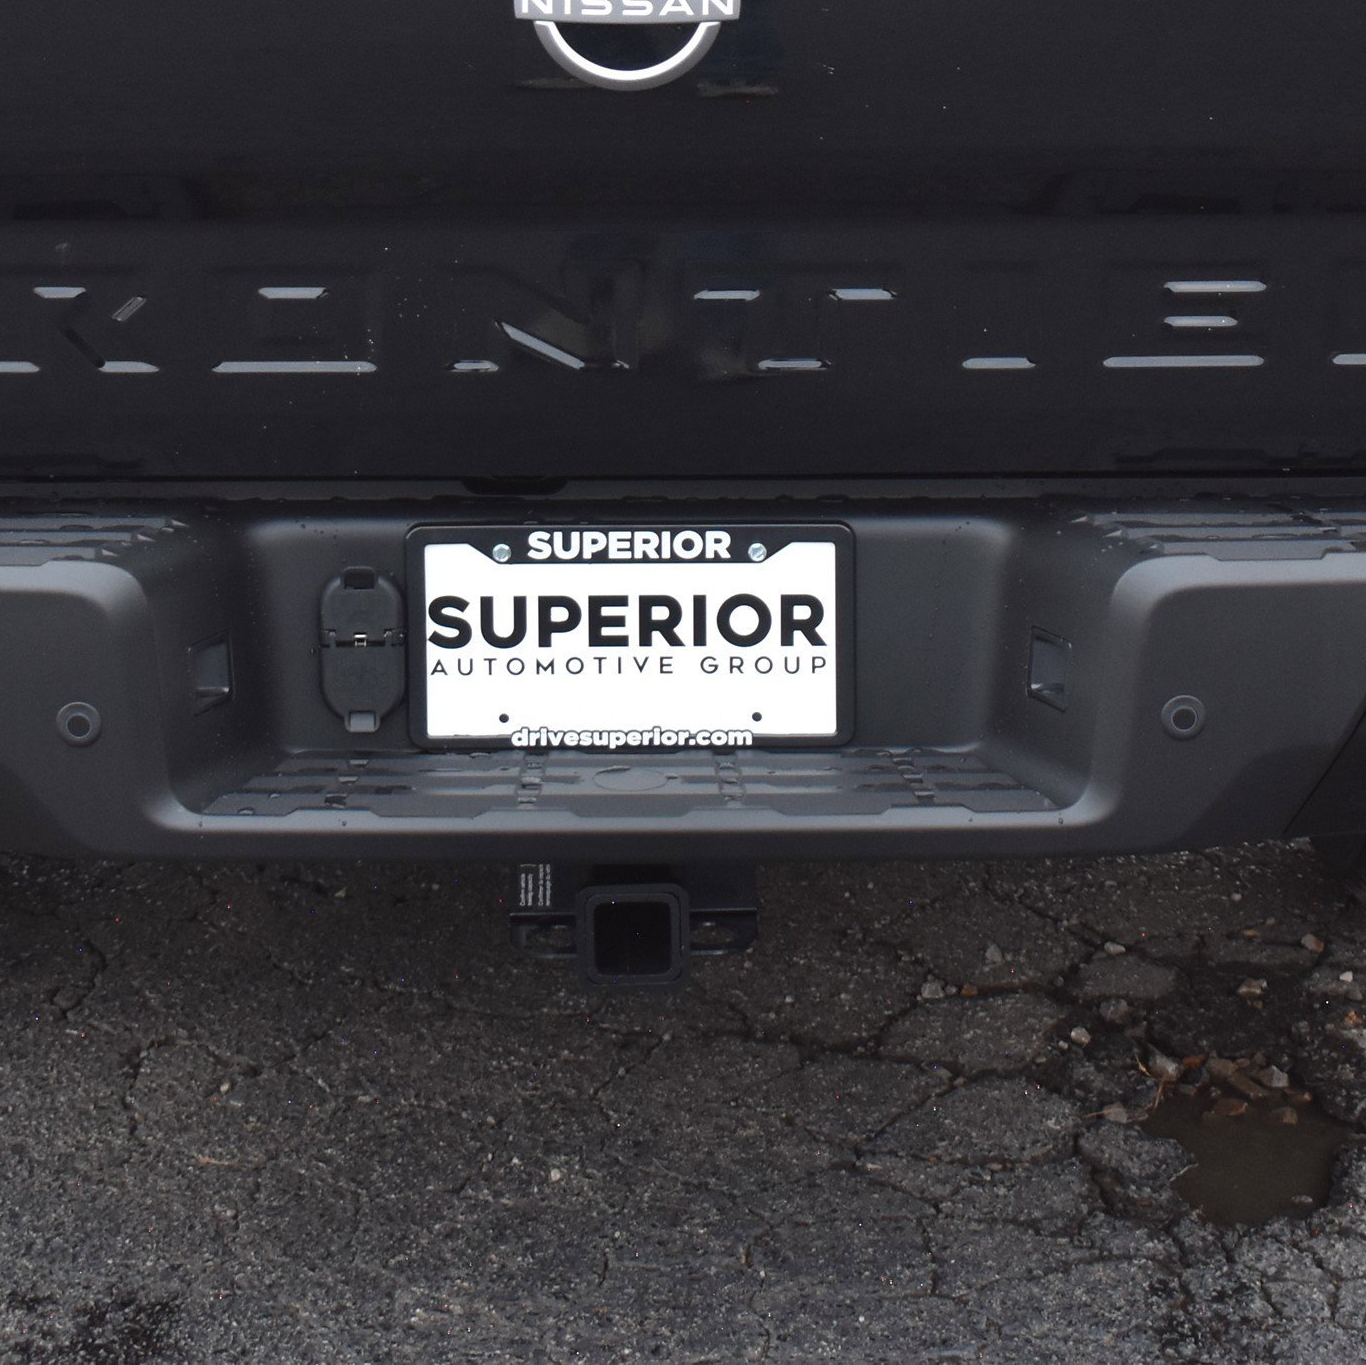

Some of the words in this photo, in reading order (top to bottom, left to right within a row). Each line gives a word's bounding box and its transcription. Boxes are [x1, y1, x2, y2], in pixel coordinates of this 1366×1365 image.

[527, 530, 731, 560] SUPERIOR
[427, 592, 827, 649] SUPERIOR
[430, 656, 673, 676] AUTOMOTIVE
[699, 655, 827, 675] GROUP
[511, 726, 753, 749] drivesuperior.com
